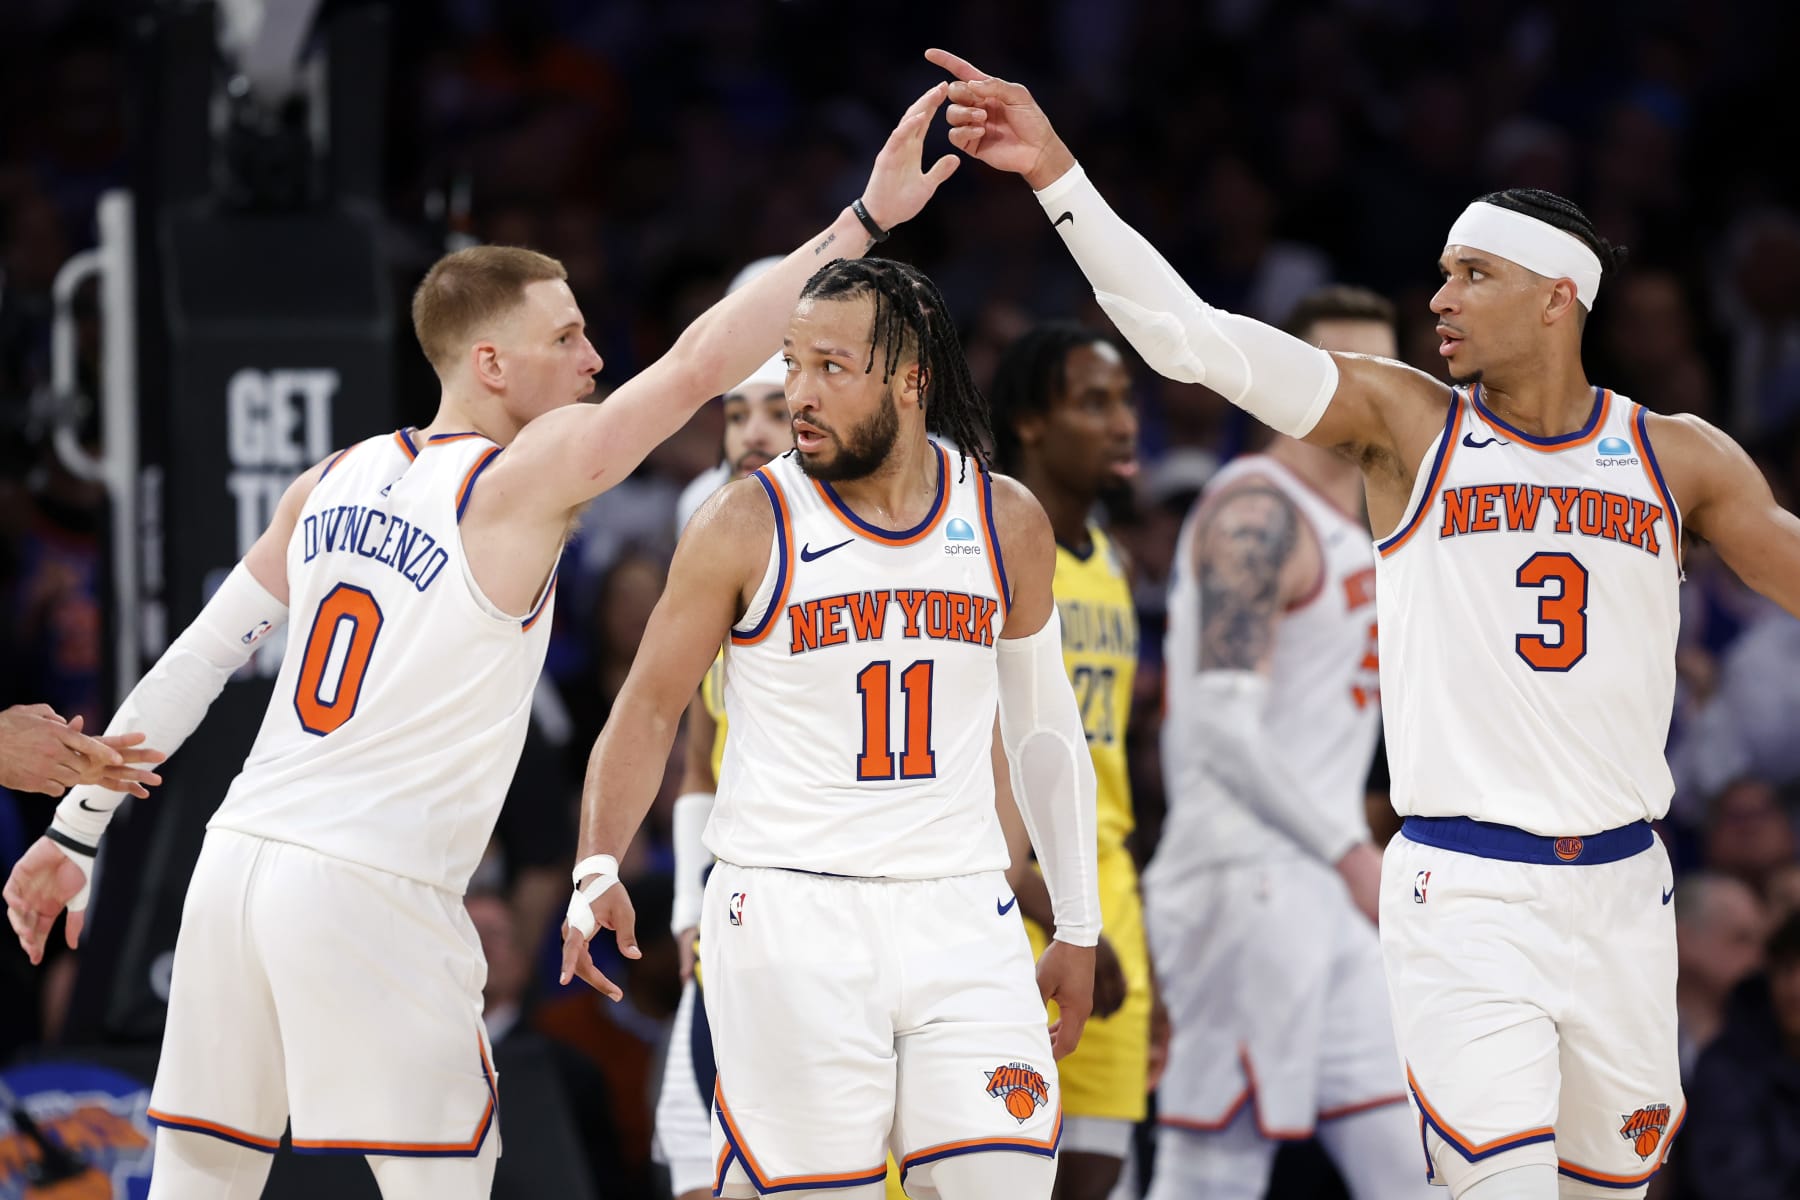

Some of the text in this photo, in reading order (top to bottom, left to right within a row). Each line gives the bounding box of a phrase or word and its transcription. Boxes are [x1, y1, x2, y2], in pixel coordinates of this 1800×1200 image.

[227, 369, 341, 466] GET
[1595, 457, 1639, 468] sphere
[944, 544, 981, 556] sphere
[1439, 483, 1663, 558] NEW YORK
[787, 588, 999, 656] NEW YORK
[1515, 551, 1589, 672] 3
[293, 581, 384, 737] 0
[856, 659, 936, 781] 11
[986, 1065, 1048, 1104] KNICKS
